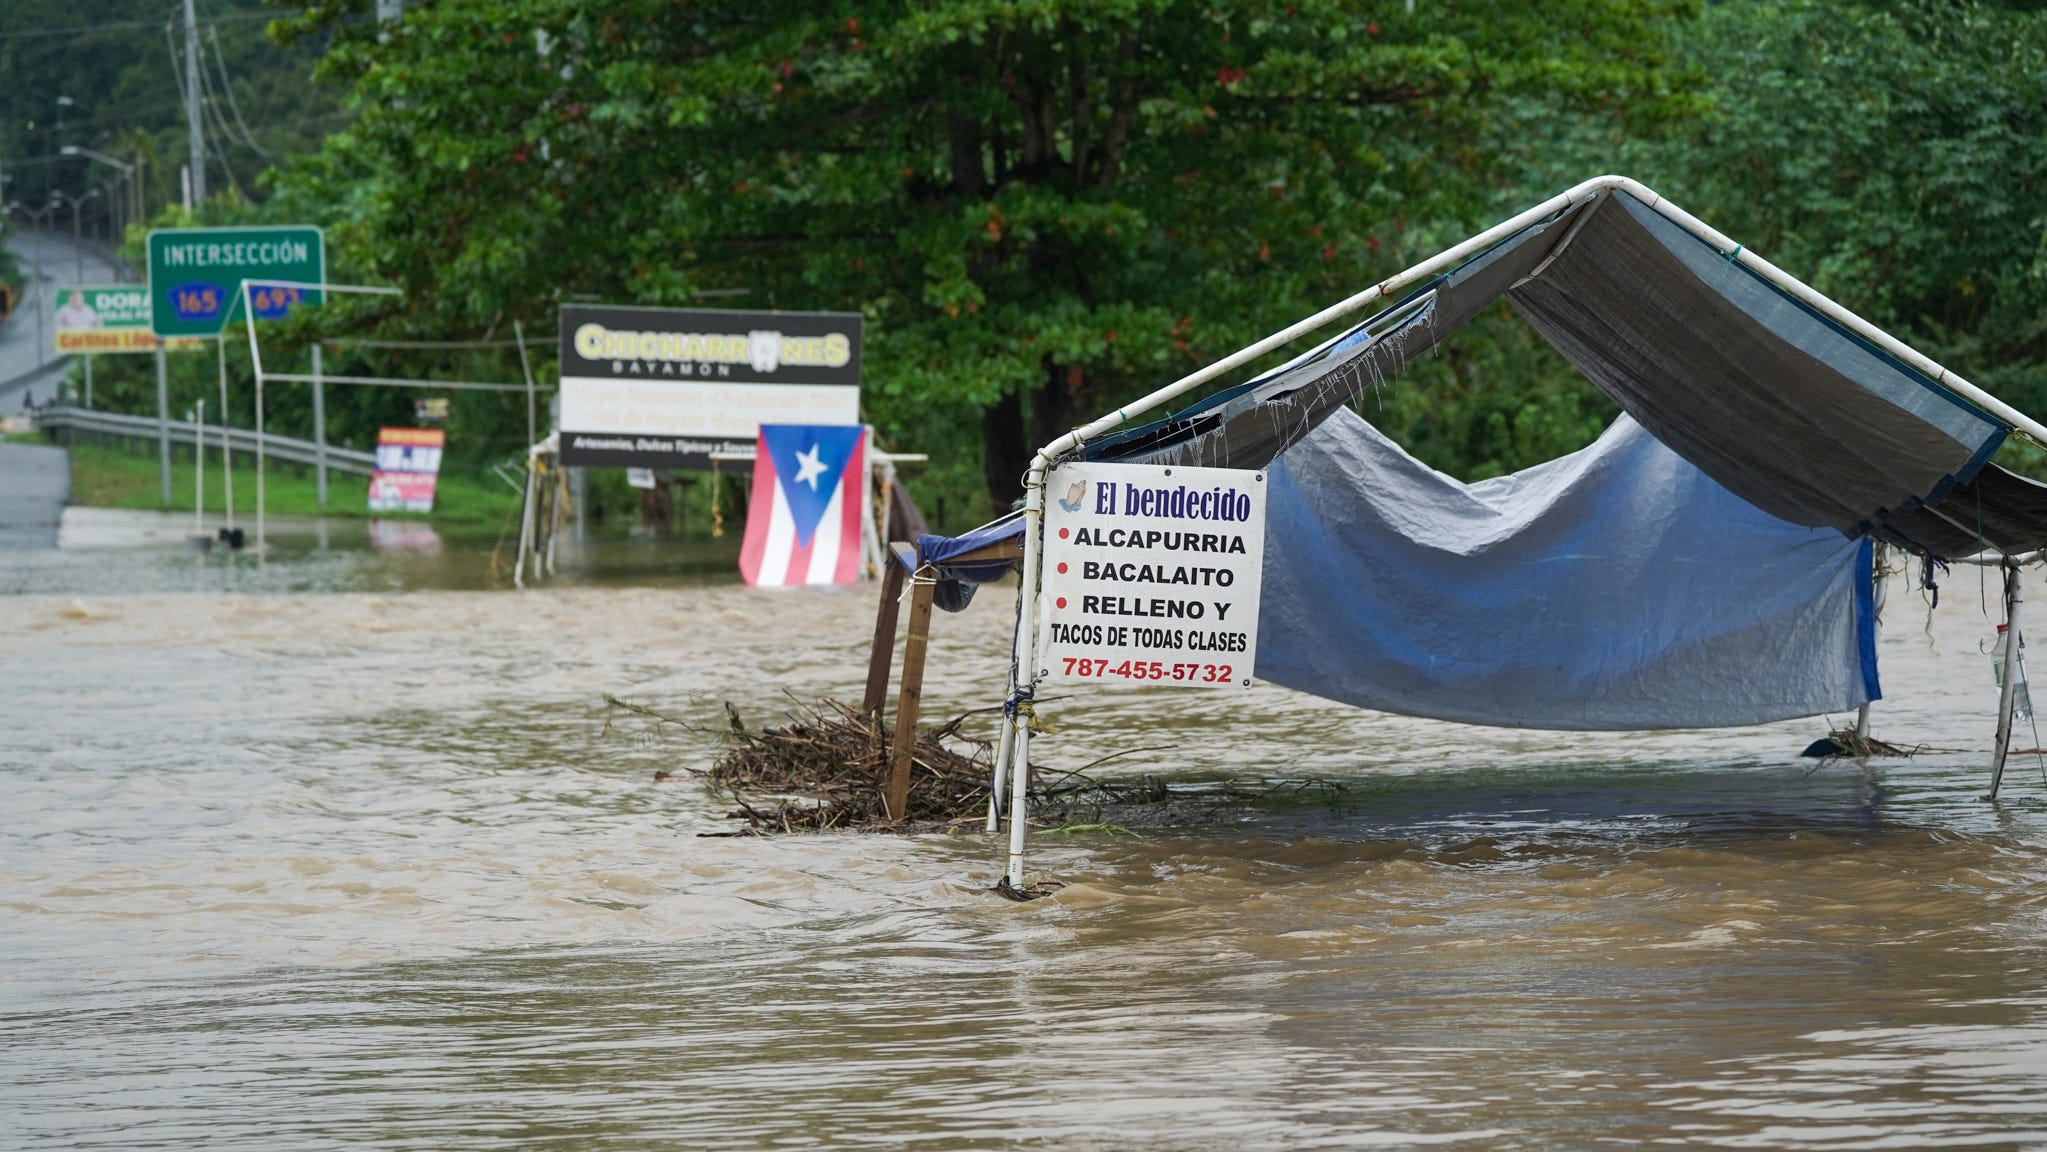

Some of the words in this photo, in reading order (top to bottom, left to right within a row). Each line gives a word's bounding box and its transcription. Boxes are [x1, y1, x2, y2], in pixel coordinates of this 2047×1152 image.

[163, 238, 308, 266] INTERSECCIÓN
[178, 289, 218, 313] 165
[1095, 482, 1117, 515] El
[1125, 483, 1250, 522] bendecido
[1073, 527, 1247, 554] ALCAPURRIA
[1083, 561, 1234, 587] BACALAITO
[1082, 595, 1205, 619] RELLENO
[1213, 602, 1232, 621] Y
[1051, 623, 1103, 646] TACOS
[1107, 626, 1128, 647] DE
[1132, 627, 1183, 650] TODAS
[1188, 630, 1247, 652] CLASES
[1062, 657, 1233, 683] 787-455-5732
